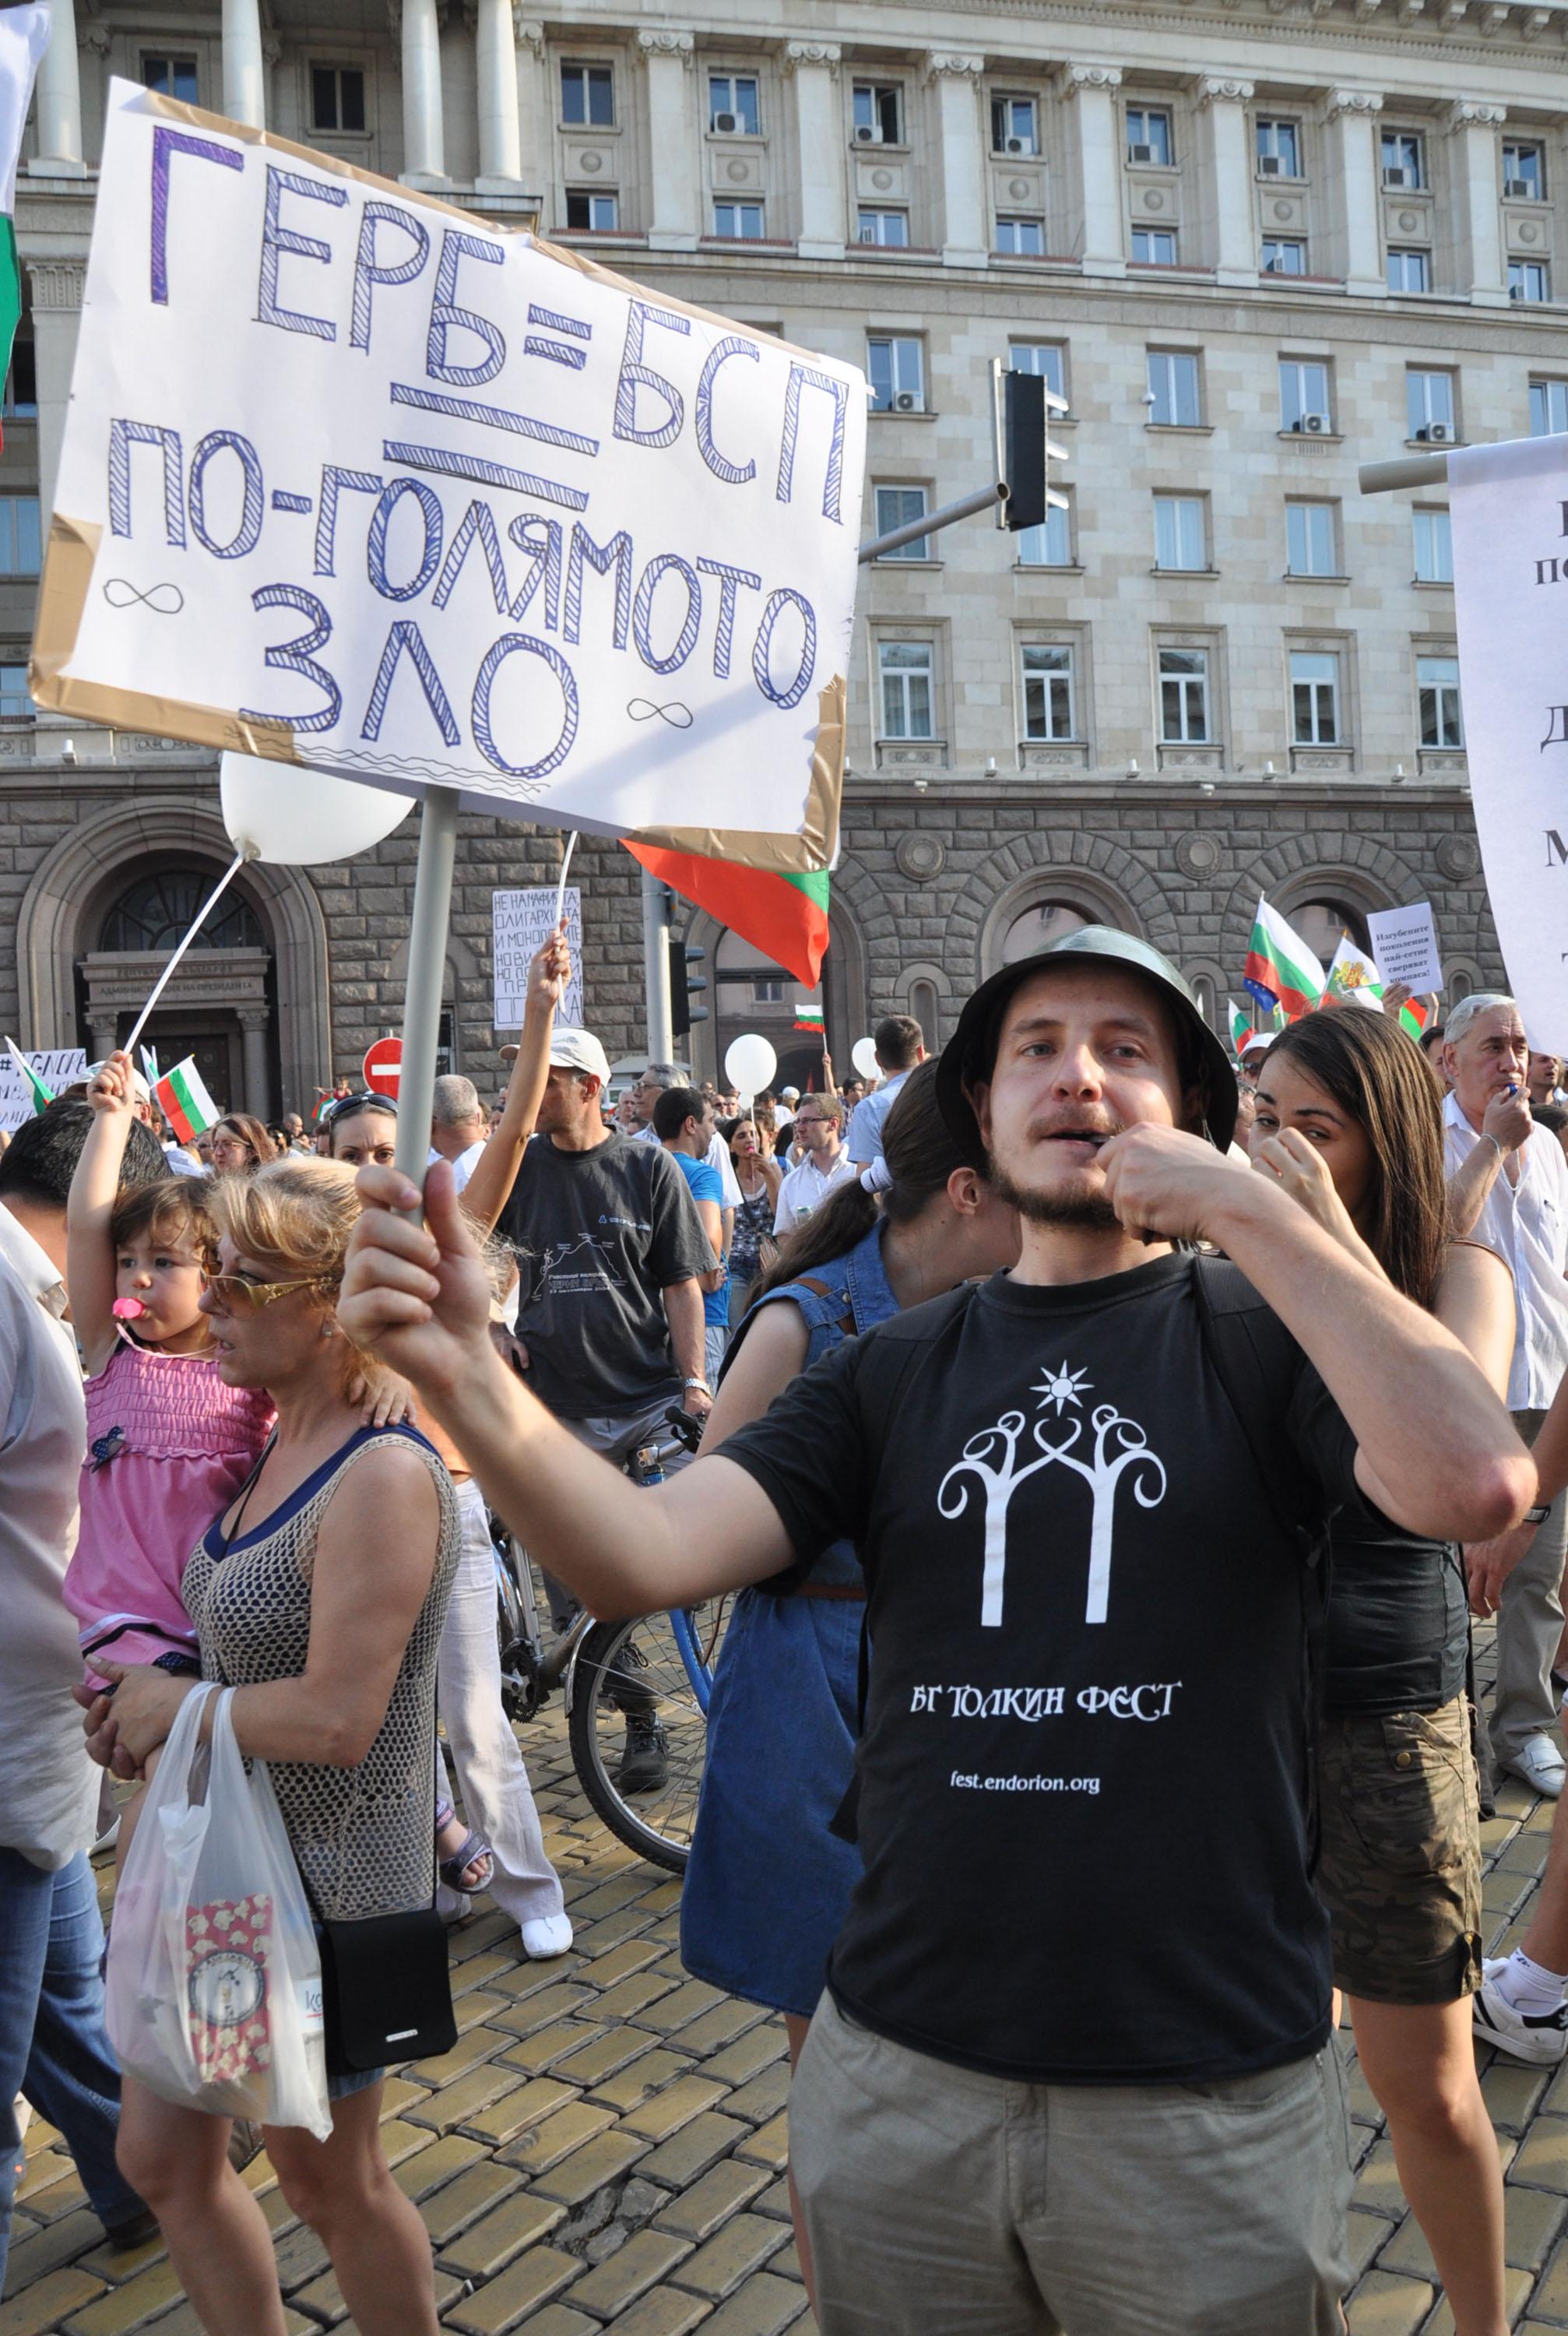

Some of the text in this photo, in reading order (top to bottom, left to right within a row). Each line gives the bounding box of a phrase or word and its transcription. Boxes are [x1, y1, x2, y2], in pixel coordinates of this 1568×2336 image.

[109, 417, 817, 709] ПО-ГОЛЯМОТО
[239, 582, 578, 778] ЗЛО
[494, 894, 508, 911] НЕ
[510, 893, 527, 909] НА
[494, 925, 581, 949] И МОНОПИТЕ
[1380, 938, 1429, 952] поколения
[1384, 948, 1429, 962] най-сетне
[1388, 959, 1428, 973] сверяват
[910, 1680, 1183, 1722] БГ ТОЛКИН ФЕСТ
[950, 1771, 1100, 1795] fest.endorion.org
